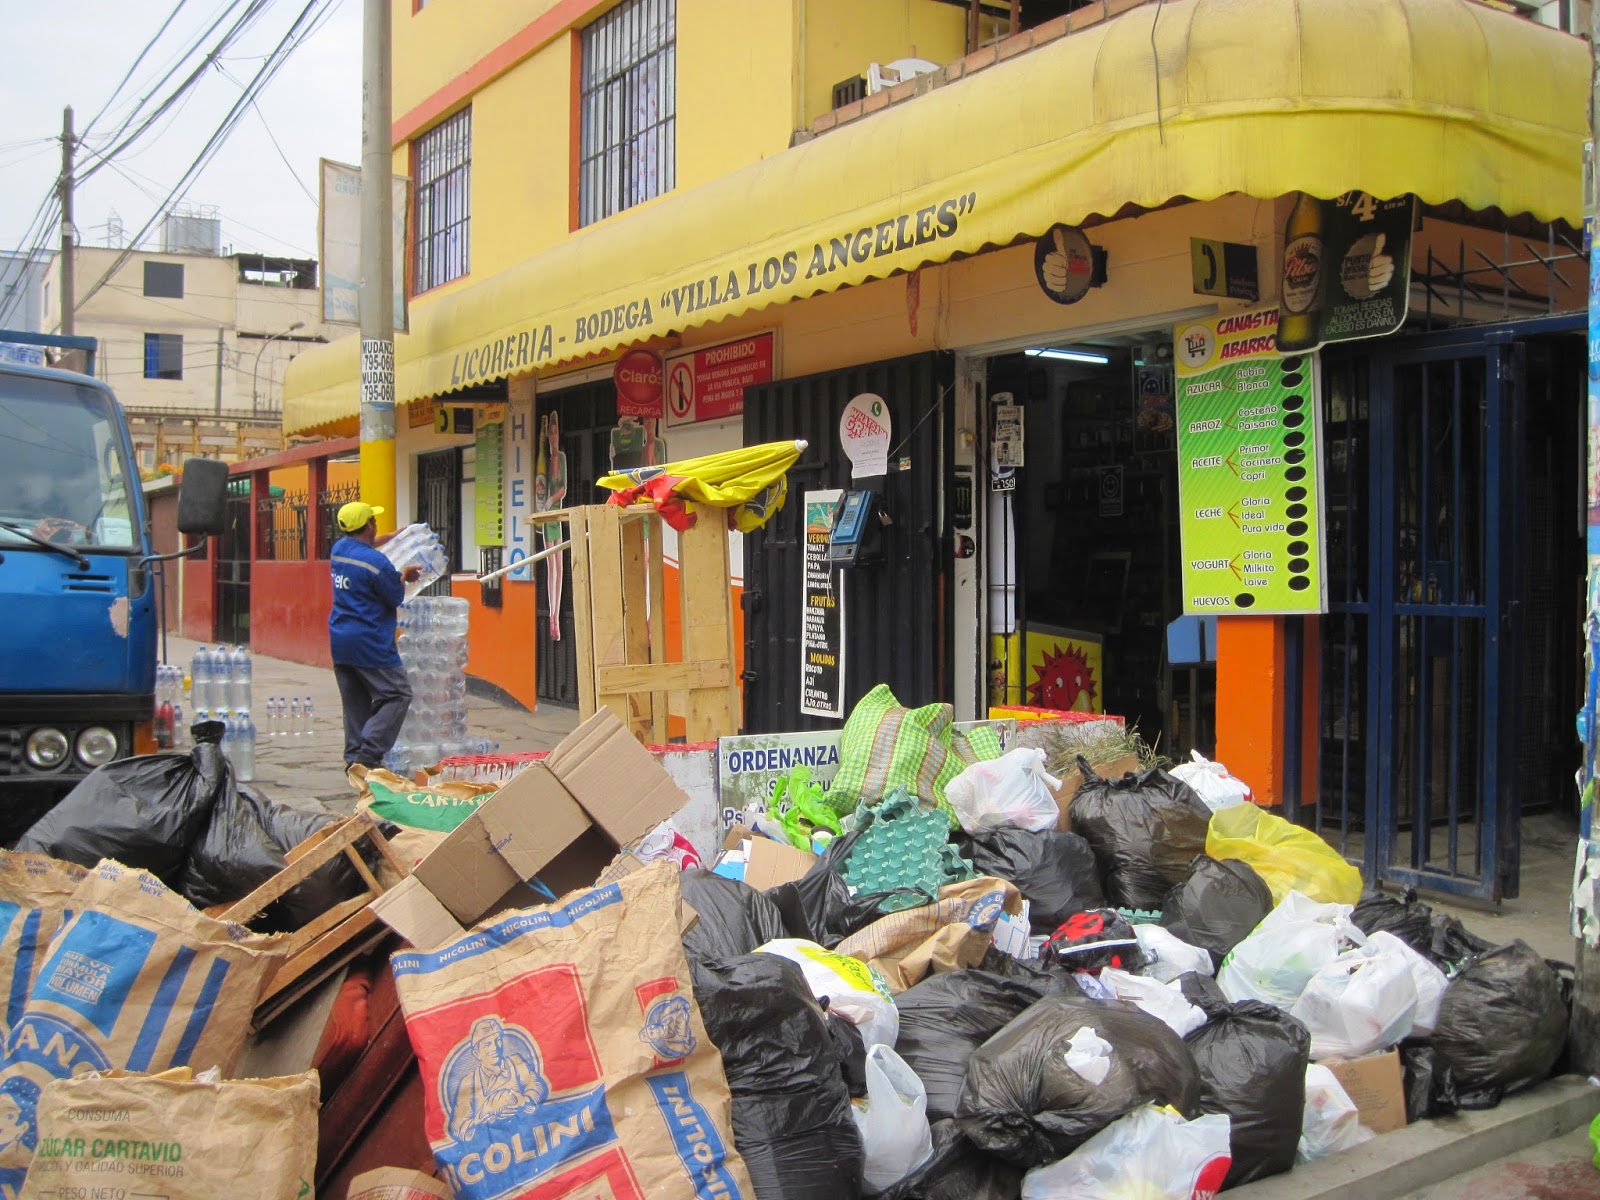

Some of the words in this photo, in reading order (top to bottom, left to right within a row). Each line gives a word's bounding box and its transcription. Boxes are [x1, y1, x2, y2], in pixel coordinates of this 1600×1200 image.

[1334, 303, 1359, 316] TOMAR
[1361, 298, 1393, 312] BEBIDAS
[450, 323, 554, 385] LICORERIA
[574, 303, 654, 345] BODEGA
[746, 251, 796, 296] LOS
[1326, 321, 1354, 335] EXCESO
[1356, 319, 1366, 331] ES
[1219, 334, 1278, 360] ABARRO
[705, 341, 756, 366] PROHIBIDO
[620, 369, 658, 385] Claro
[1237, 367, 1265, 378] Rubia
[1187, 382, 1222, 395] AZUCAR
[1238, 380, 1269, 392] Blanca
[620, 405, 662, 417] RECARGA
[1238, 405, 1277, 417] Costeño
[1190, 419, 1222, 433] ARROZ
[1239, 444, 1270, 454] Primor
[1192, 457, 1222, 468] ACEITE
[1240, 456, 1281, 468] Cocinero
[1240, 471, 1266, 482] Capri
[510, 412, 527, 577] HIELO
[1242, 497, 1270, 507] Gloria
[1195, 508, 1222, 519] LECHE
[1242, 510, 1265, 520] Ideal
[1242, 524, 1262, 533] Pura
[1264, 522, 1285, 532] vida
[808, 533, 831, 544] VERDU
[807, 543, 825, 552] TOMATE
[1243, 550, 1272, 560] Gloria
[807, 562, 821, 571] PAPA
[1191, 559, 1229, 570] YOGURT
[1243, 563, 1275, 573] Milkito
[1244, 577, 1268, 587] Laive
[810, 595, 836, 608] FRUTAS
[1193, 596, 1230, 606] HUEVOS
[805, 663, 823, 675] ROCOTO
[805, 688, 828, 701] CULANTRO
[66, 868, 88, 878] BLAN
[139, 884, 163, 898] NIEVE
[568, 890, 613, 918] NICOLINI
[439, 938, 487, 963] NICOLINI
[49, 975, 99, 1003] VOLUMEN
[67, 1108, 131, 1122] CONSUMA
[91, 1138, 182, 1163] CARTAVIO
[75, 1162, 125, 1174] CALIDAD
[128, 1162, 184, 1178] SUPERIOR
[59, 1187, 87, 1200] PESO
[90, 1187, 126, 1200] NETO
